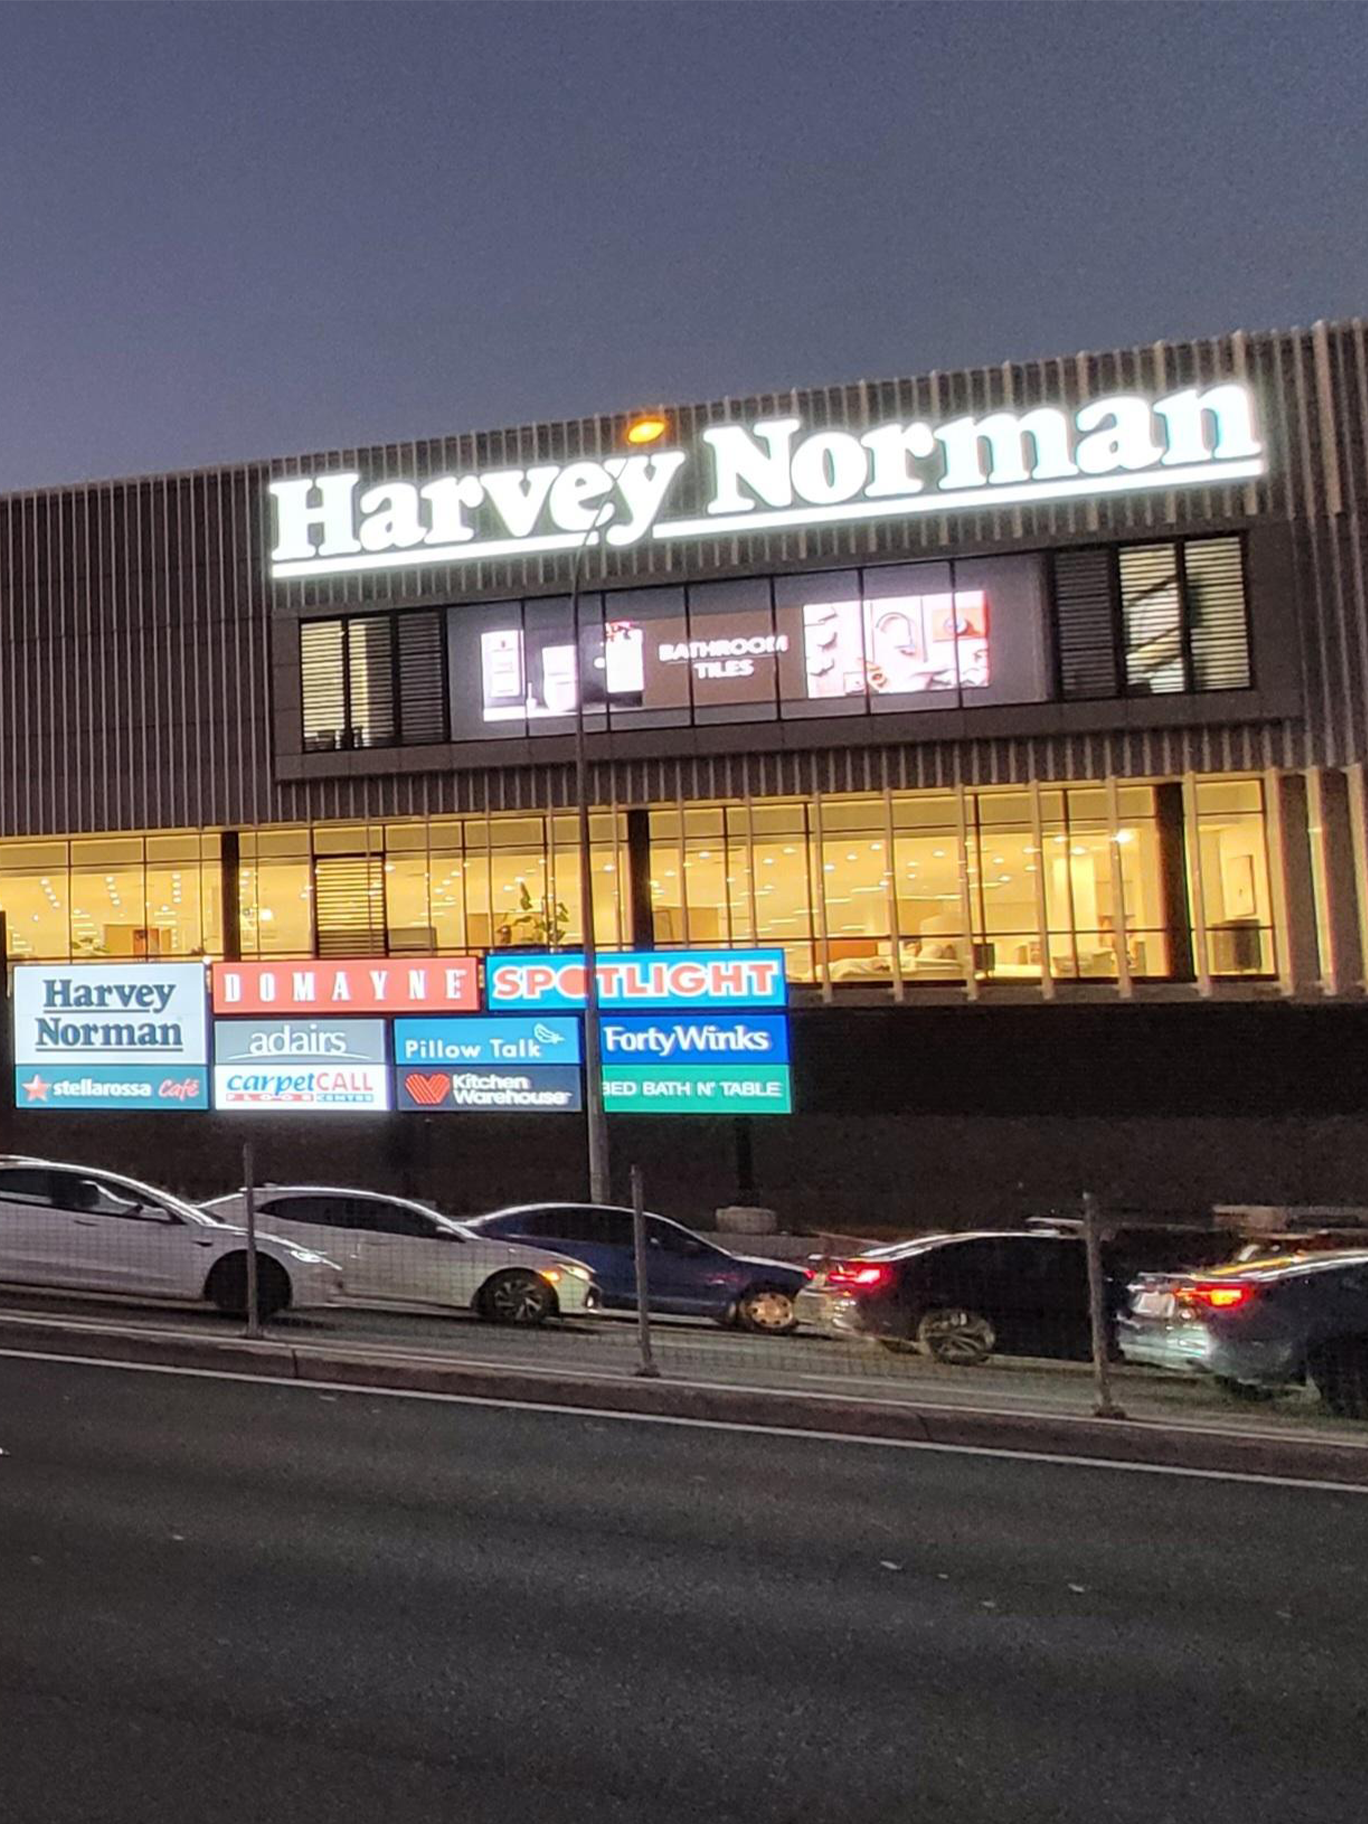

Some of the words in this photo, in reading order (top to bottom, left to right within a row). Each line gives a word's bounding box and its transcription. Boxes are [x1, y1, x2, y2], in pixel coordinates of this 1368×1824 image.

[269, 451, 684, 561] Harvey
[703, 383, 1262, 515] Norman
[658, 635, 789, 662] BATHROOM
[693, 659, 754, 679] TILES
[224, 969, 466, 1002] DOMAYNE
[493, 962, 779, 999] SPOTLIGHT
[43, 979, 176, 1013] Harvey
[35, 1017, 183, 1046] Norman
[249, 1024, 346, 1055] adairs
[405, 1040, 481, 1058] Pillow
[489, 1038, 541, 1058] Talk
[53, 1079, 152, 1097] stellarossa
[158, 1078, 200, 1101] Café
[452, 1073, 530, 1090] Kitchen
[642, 1081, 692, 1096] BATH
[720, 1081, 782, 1097] TABLE
[453, 1089, 568, 1105] Warehouse
